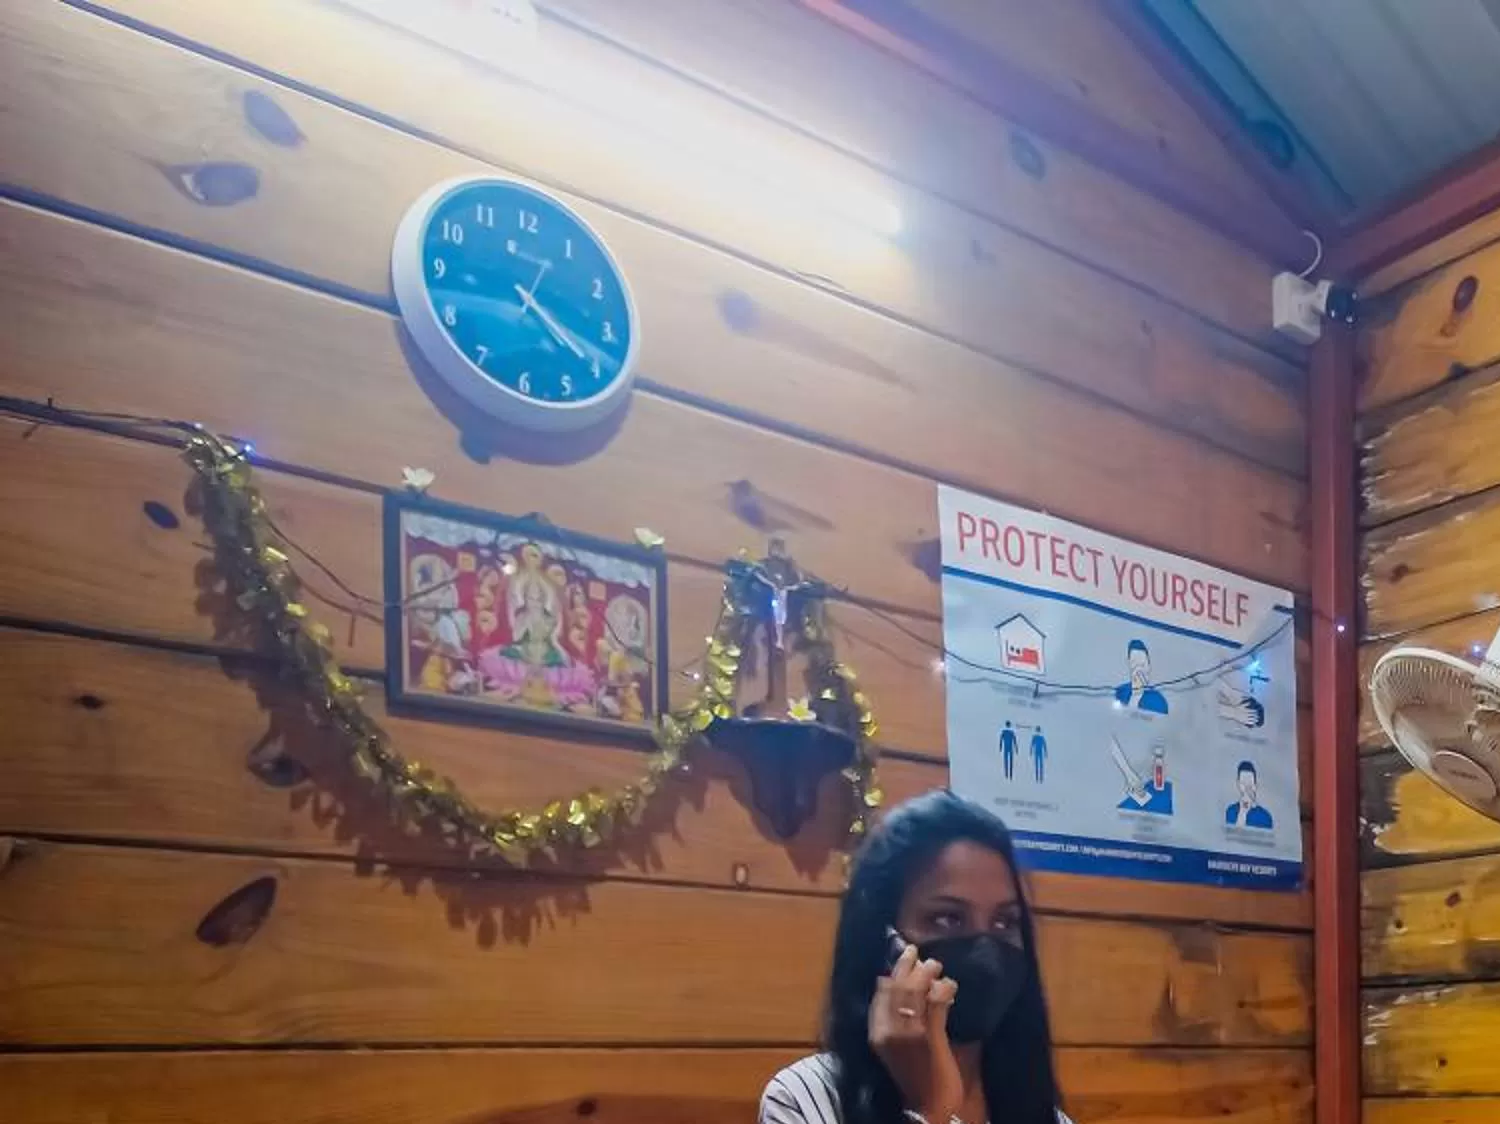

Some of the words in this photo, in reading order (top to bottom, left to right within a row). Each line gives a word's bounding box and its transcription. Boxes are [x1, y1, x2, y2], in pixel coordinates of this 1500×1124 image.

[475, 203, 495, 229] 11
[518, 209, 540, 234] 12
[441, 219, 464, 245] 10
[565, 238, 573, 260] 1
[433, 257, 447, 280] 9
[591, 278, 604, 301] 2
[443, 304, 458, 327] 8
[602, 321, 615, 343] 3
[475, 344, 490, 367] 7
[589, 356, 601, 380] 4
[518, 371, 531, 395] 6
[560, 374, 573, 397] 5
[957, 511, 1104, 588] PROTECT
[1111, 555, 1249, 627] YOURSELF
